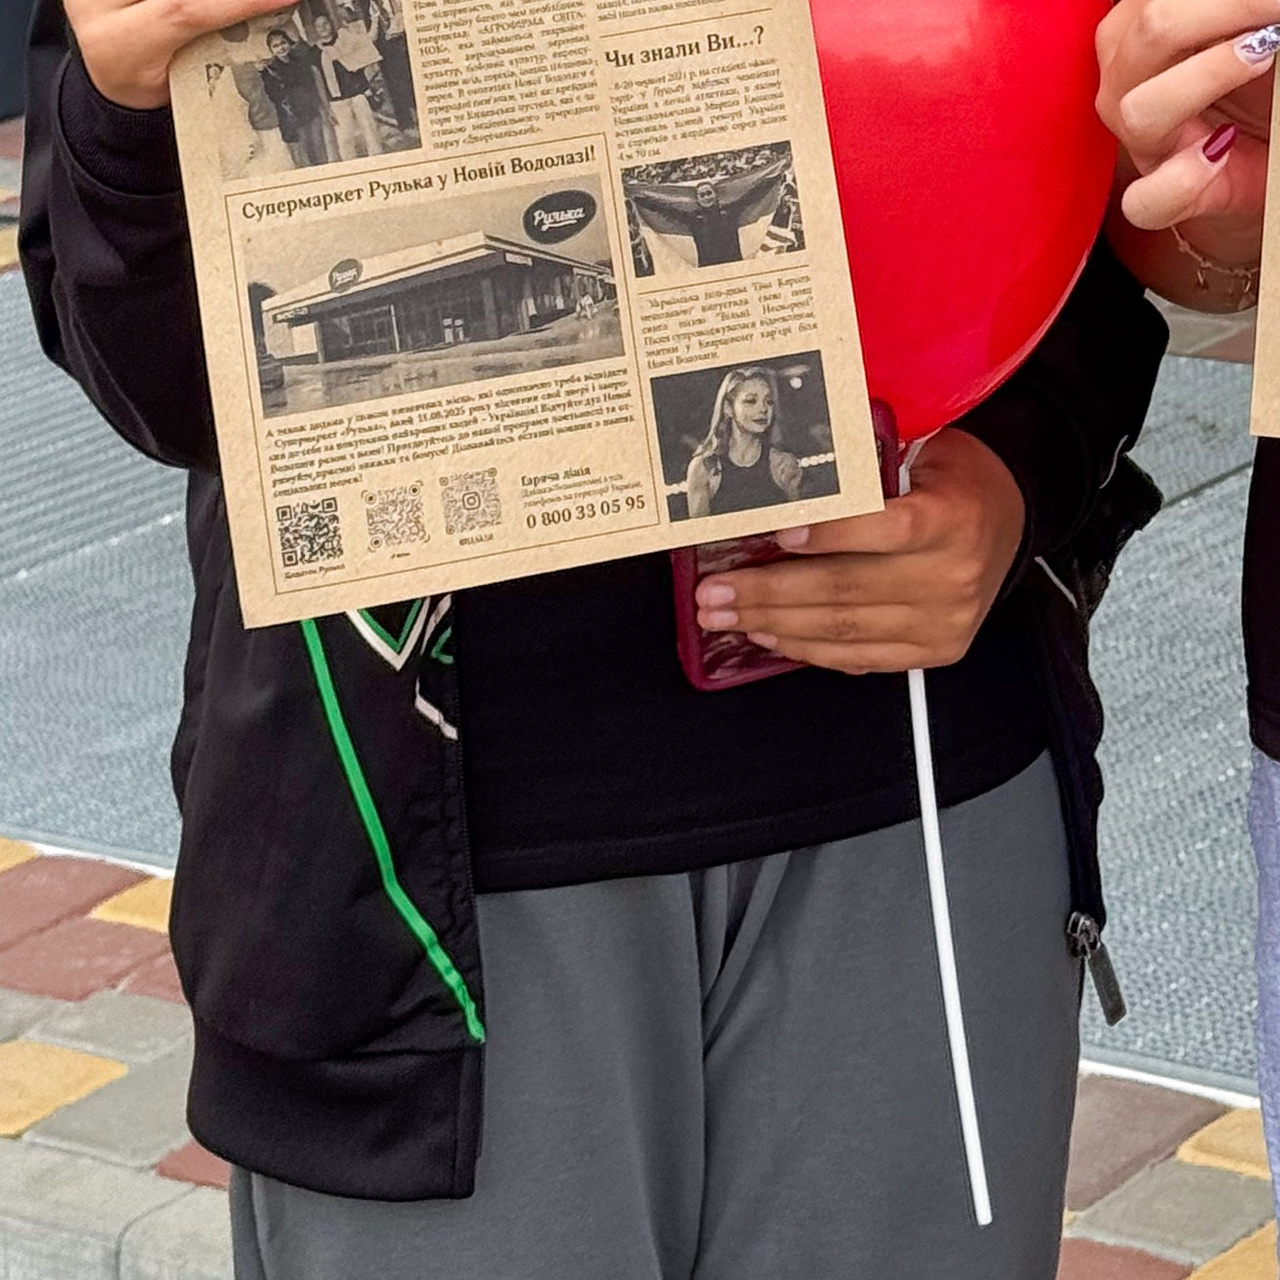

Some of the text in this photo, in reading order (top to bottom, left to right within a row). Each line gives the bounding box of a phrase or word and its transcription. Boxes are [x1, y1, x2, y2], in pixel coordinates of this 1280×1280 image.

[605, 26, 764, 67] Чи знали Ви...?
[242, 145, 594, 221] Супермаркет Рулька у Новій Водолазі!
[532, 202, 586, 231] Рулька
[527, 495, 645, 528] 0 800 33 05 95
